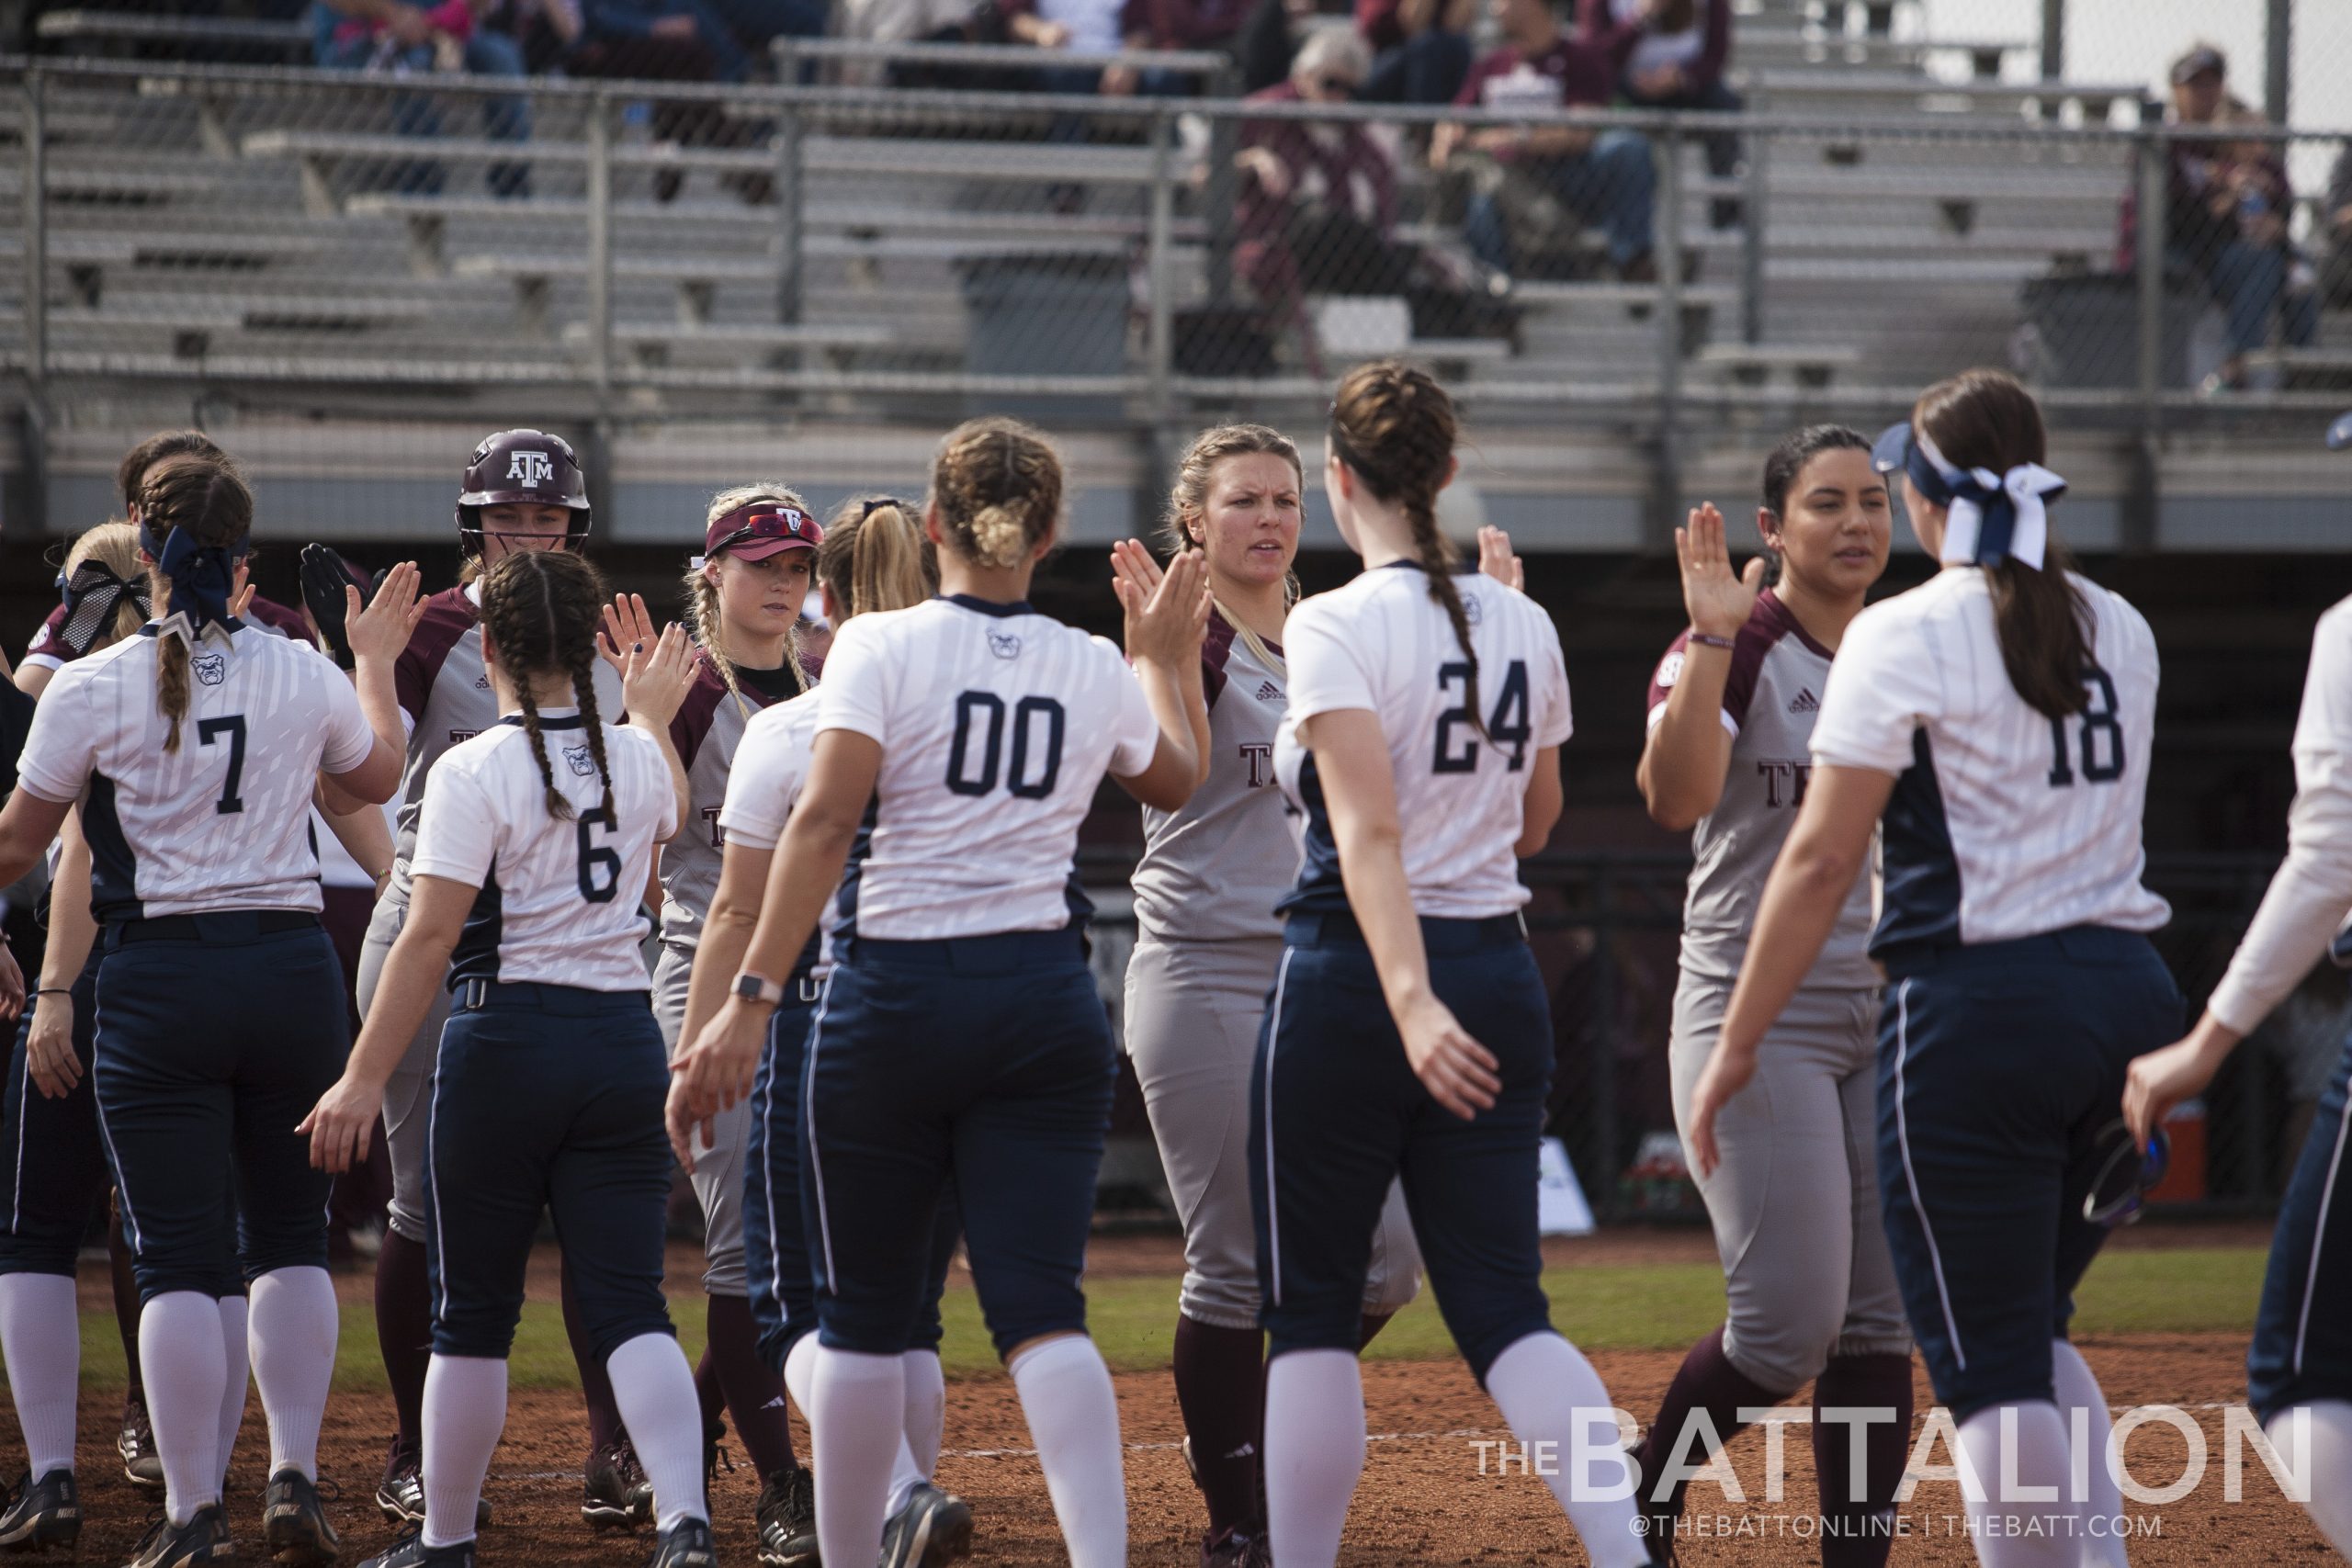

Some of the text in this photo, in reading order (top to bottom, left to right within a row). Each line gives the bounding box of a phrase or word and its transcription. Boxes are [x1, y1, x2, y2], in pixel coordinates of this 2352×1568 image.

[197, 715, 247, 815] 7
[945, 690, 1065, 800] 00
[1432, 660, 1532, 773] 24
[2048, 668, 2126, 786] 18
[577, 807, 622, 904] 6
[56, 1507, 76, 1519] NIKE
[275, 1503, 301, 1517] NIKE
